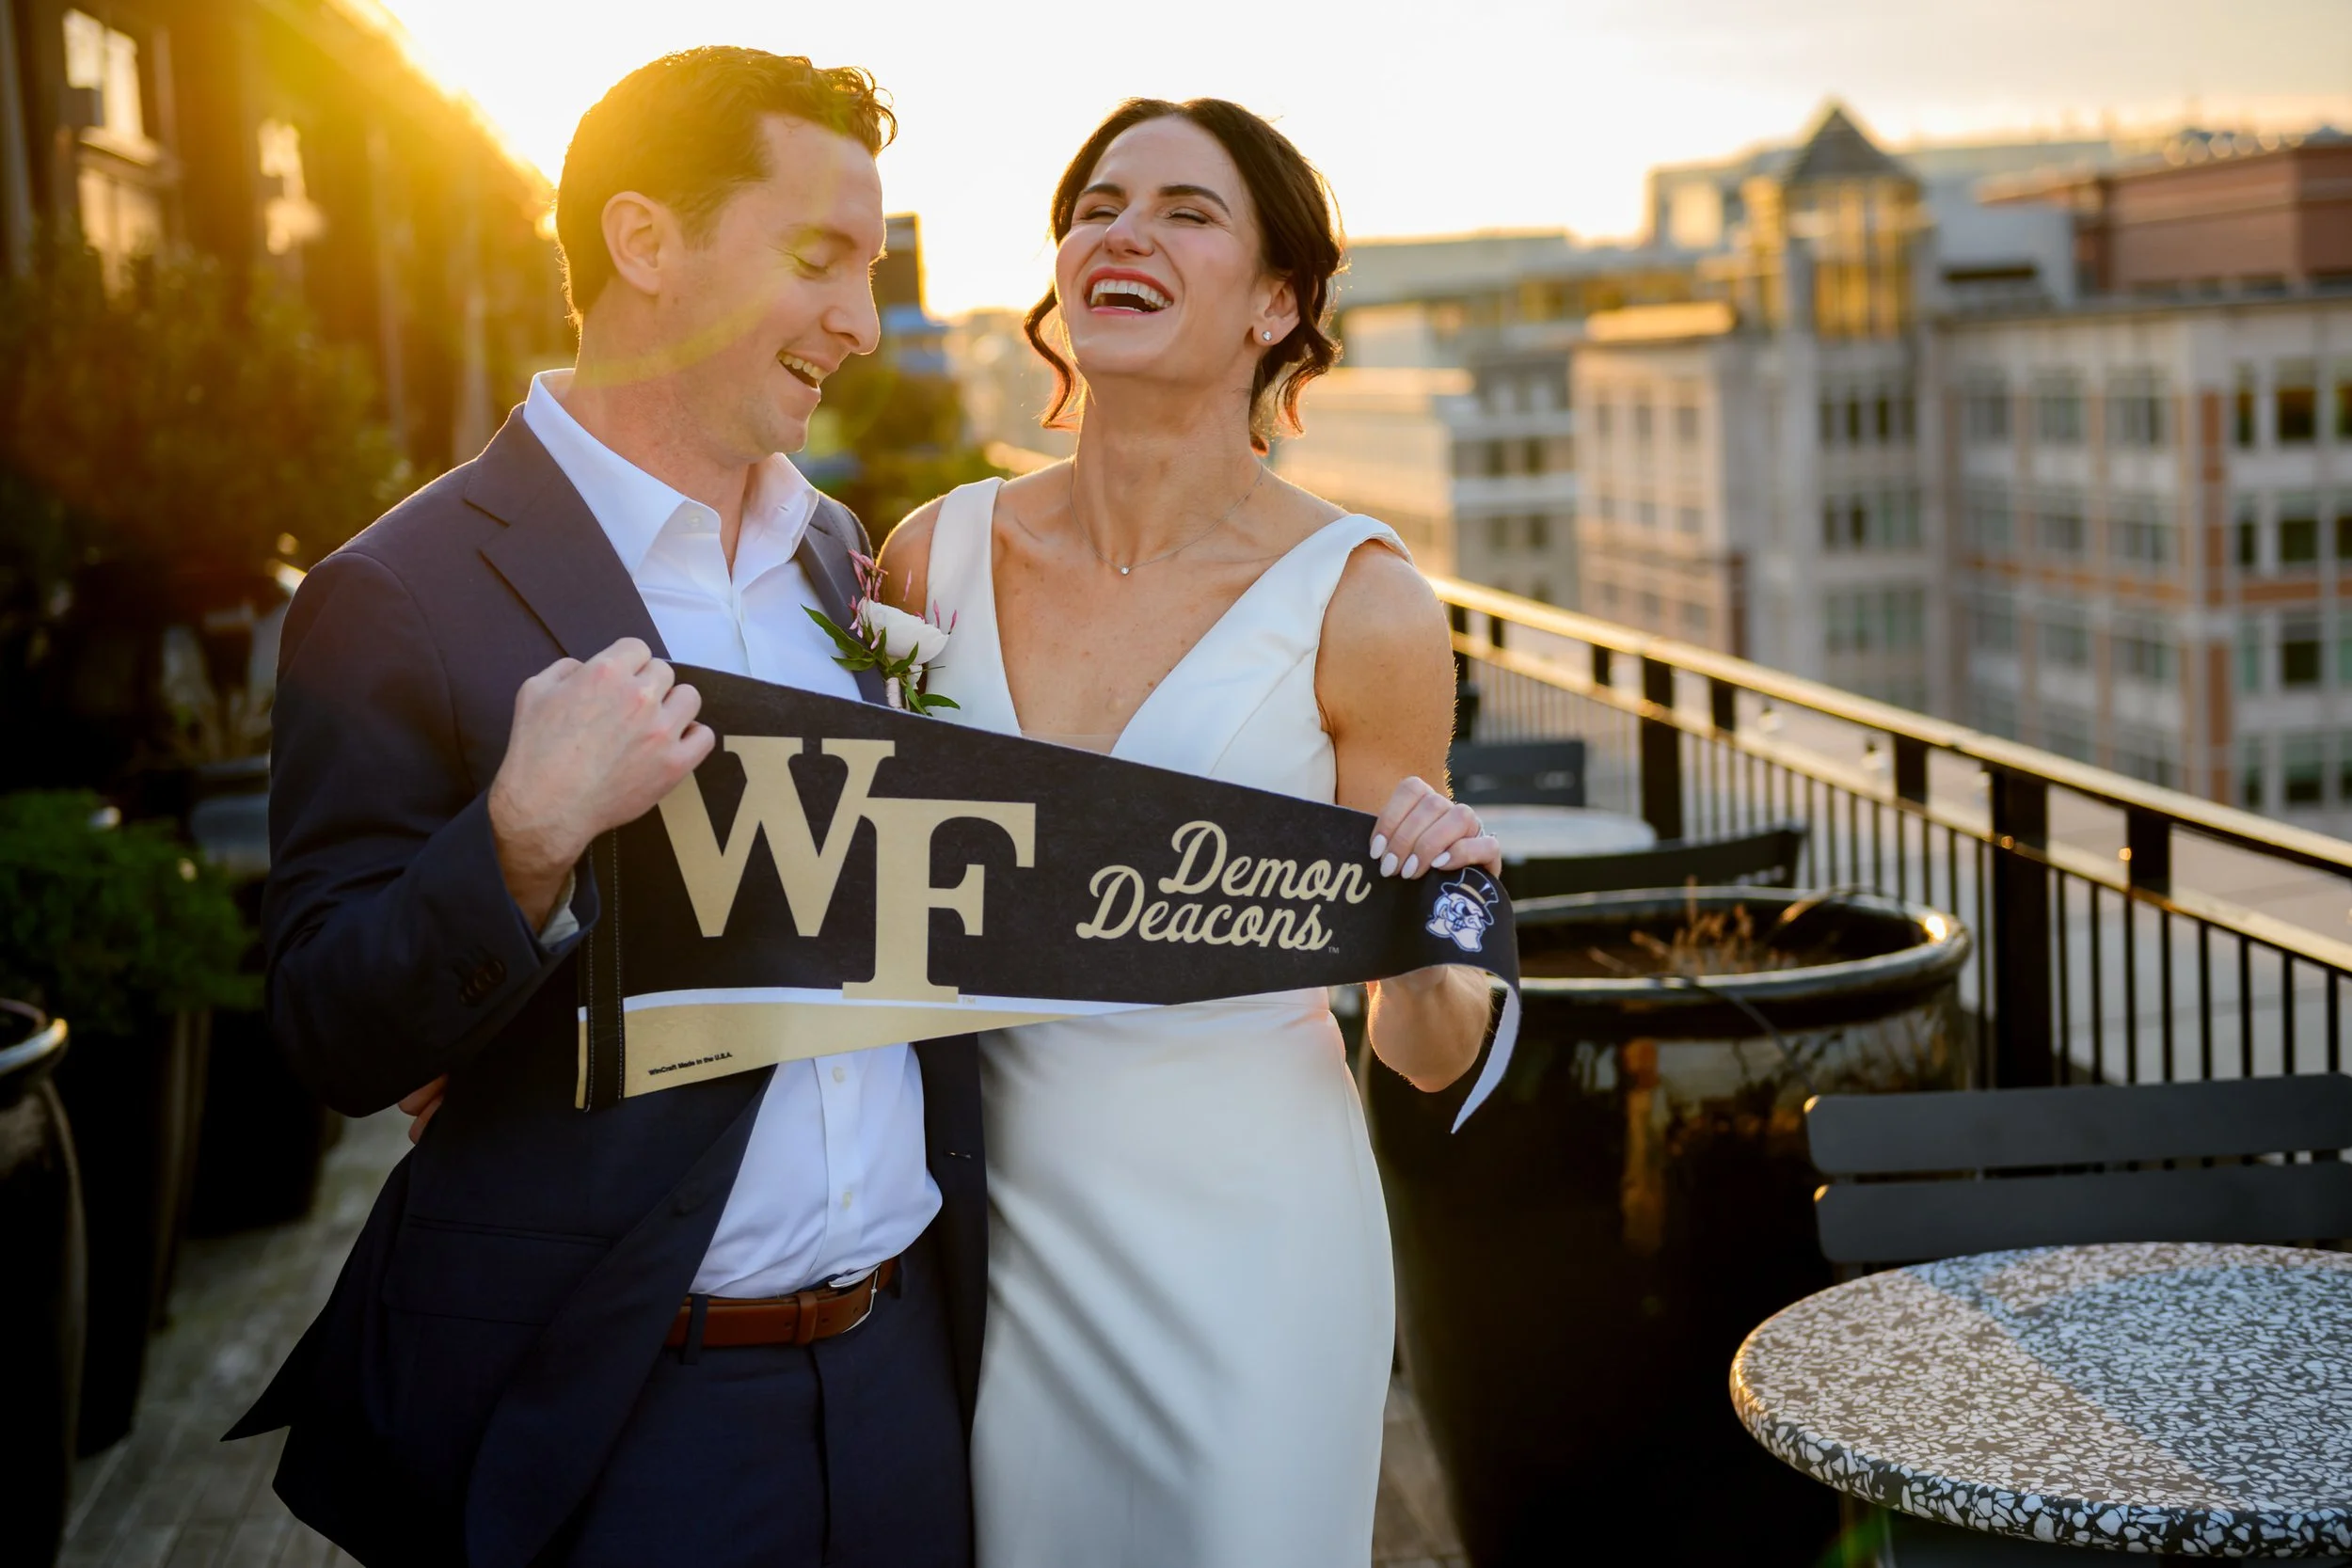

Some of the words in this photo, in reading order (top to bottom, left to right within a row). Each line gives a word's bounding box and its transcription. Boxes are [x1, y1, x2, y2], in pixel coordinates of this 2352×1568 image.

[658, 735, 1036, 1003] WF
[1157, 820, 1372, 904] Demon
[1075, 864, 1332, 951] Deacons
[648, 1065, 676, 1075] WinCraft
[677, 1060, 695, 1069] Made
